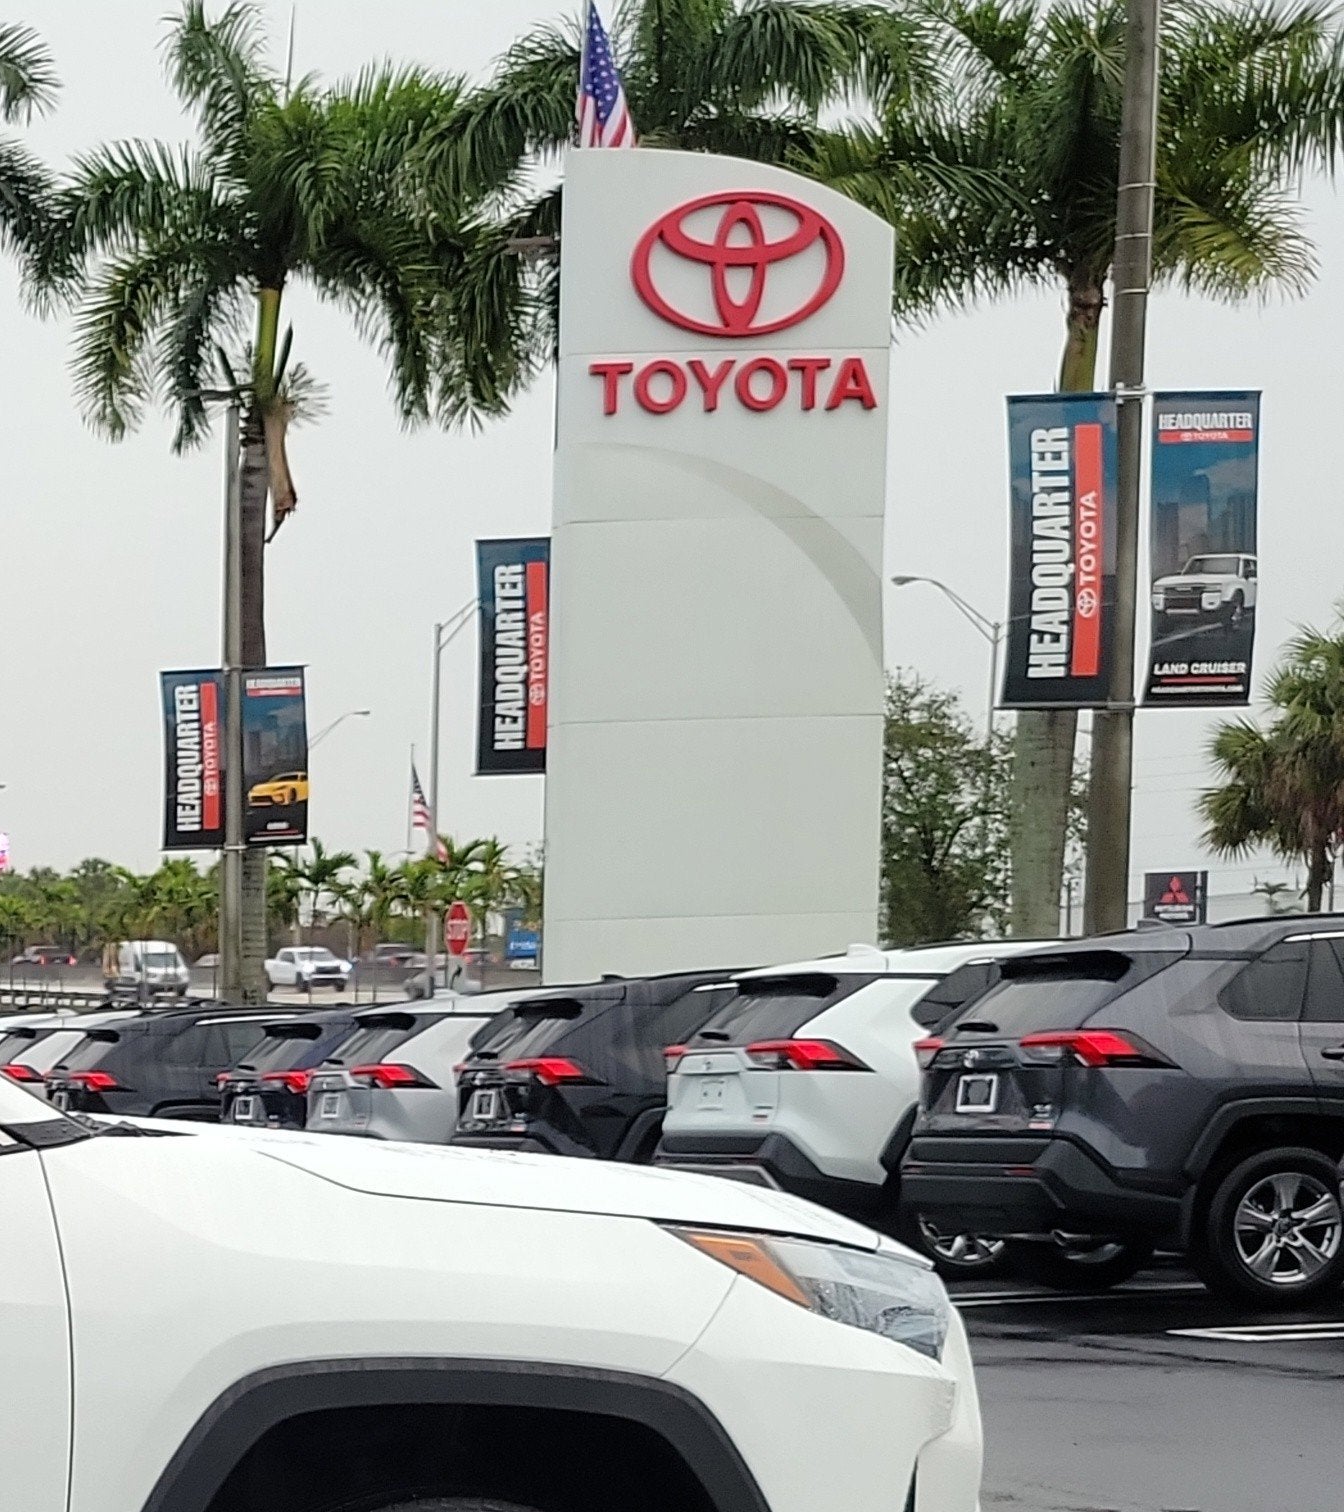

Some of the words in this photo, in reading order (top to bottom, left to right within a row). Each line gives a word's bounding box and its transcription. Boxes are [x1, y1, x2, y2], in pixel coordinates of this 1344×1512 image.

[589, 357, 878, 415] TOYOTA
[1158, 412, 1253, 431] HEADQUARTER
[1026, 427, 1075, 679] HEADQUARTER
[1079, 490, 1097, 586] TOYOTA
[493, 563, 528, 750] HEADQUARTER
[529, 612, 546, 684] TOYOTA
[1153, 662, 1189, 675] LAND
[1190, 662, 1246, 674] CRUISER
[174, 683, 204, 832] HEADQUARTER
